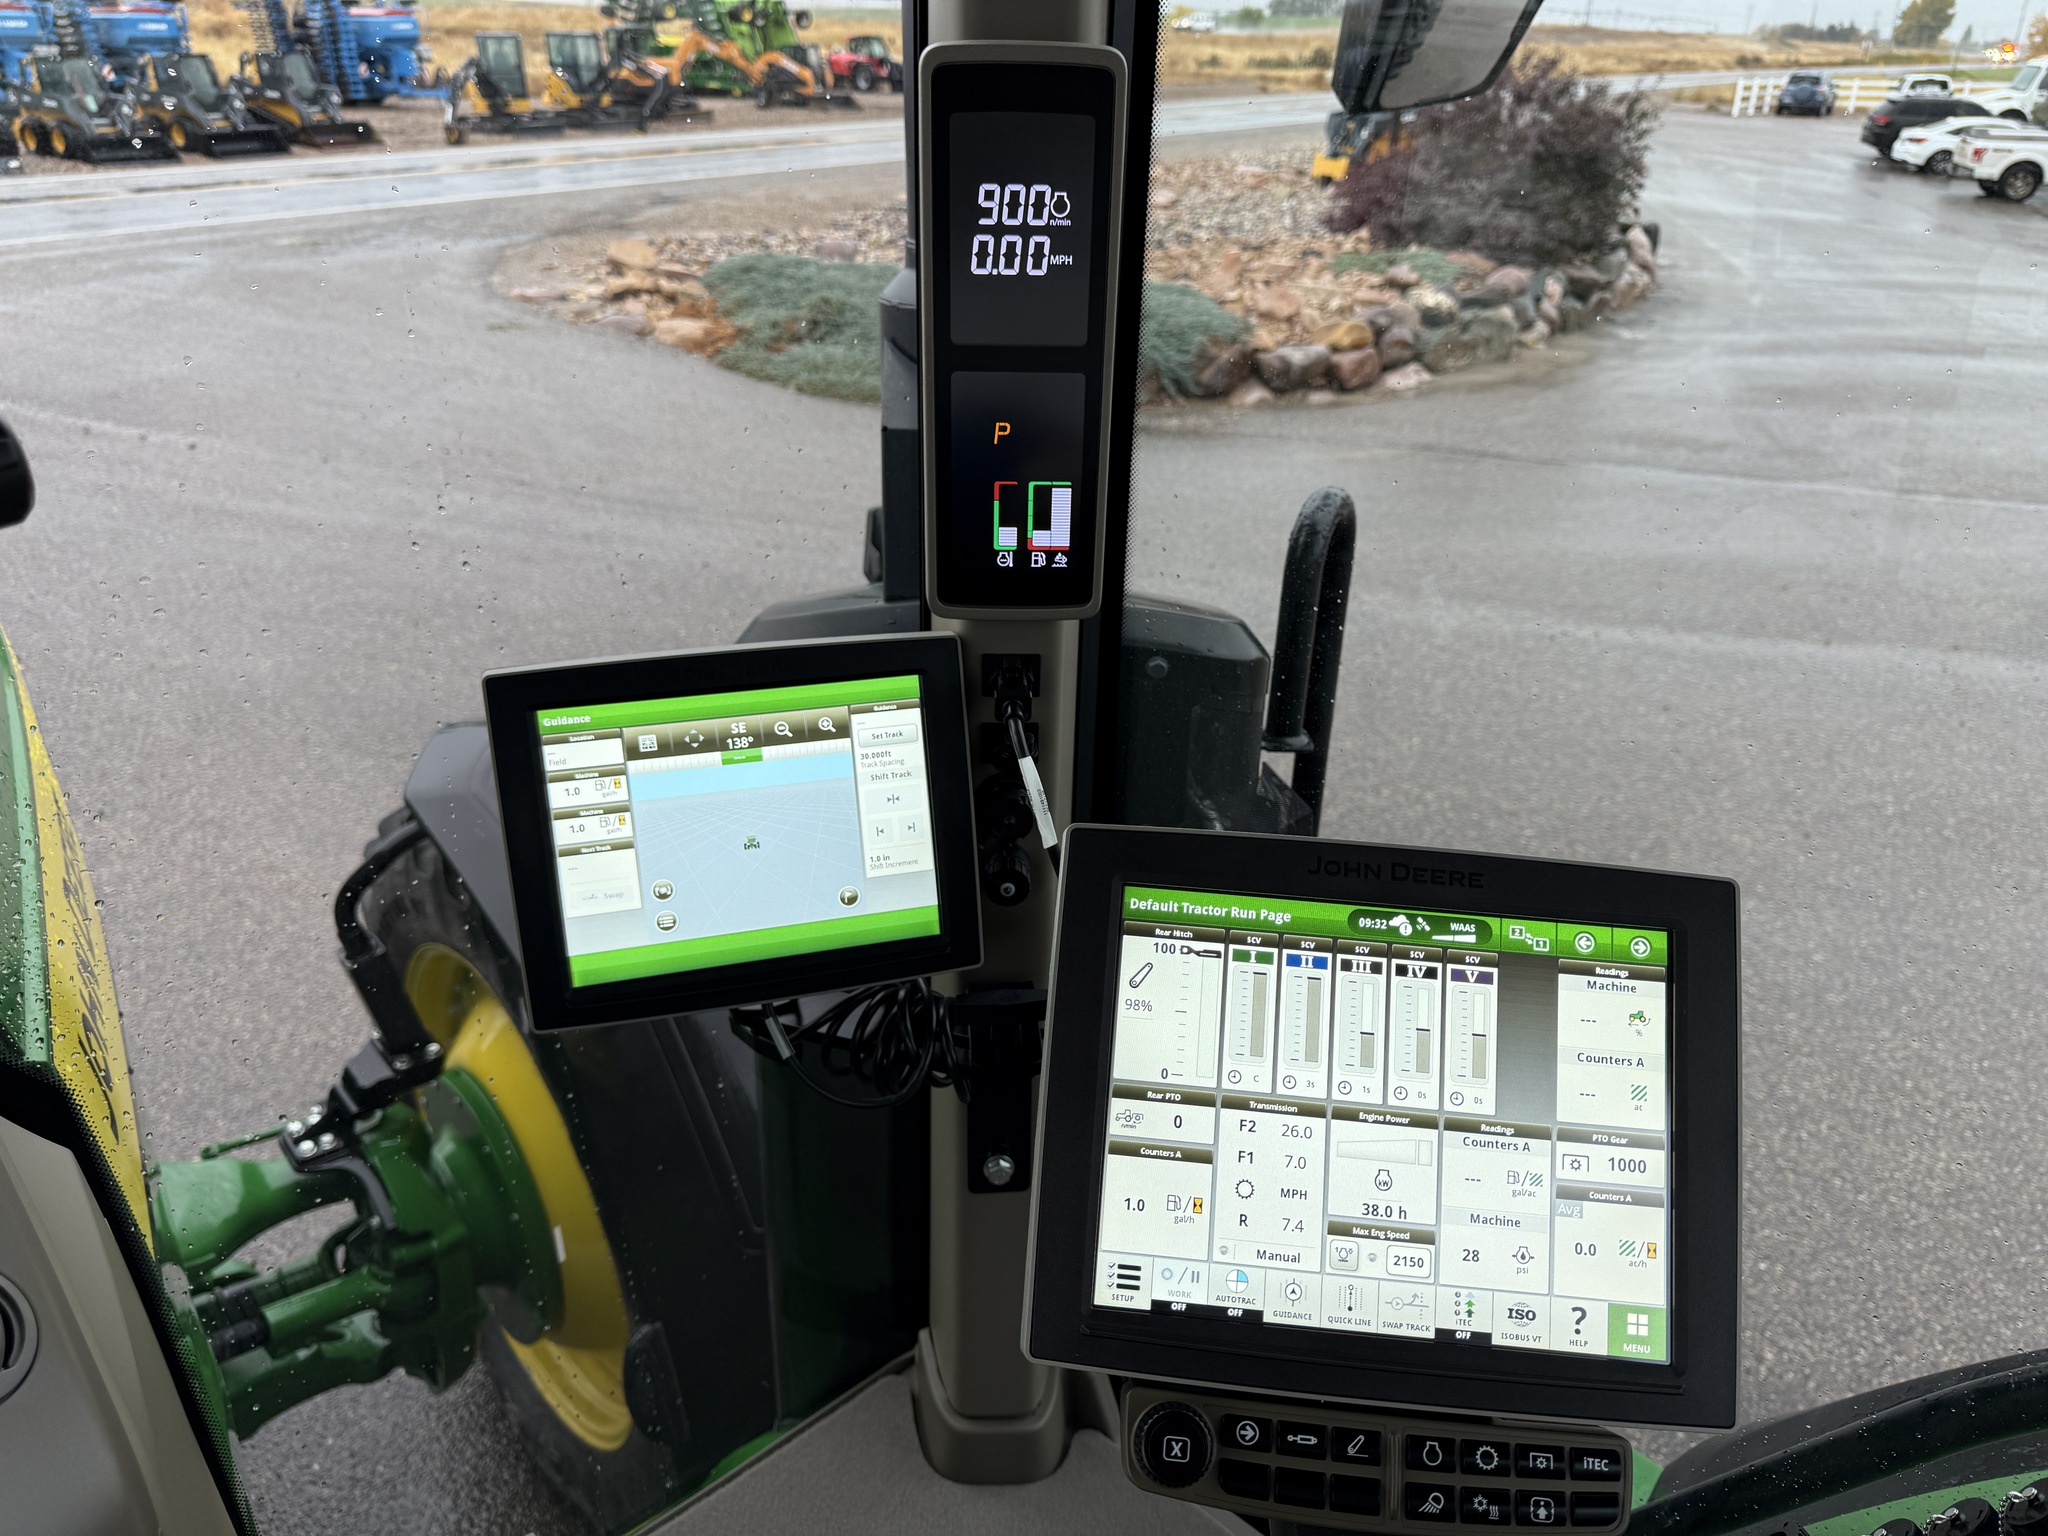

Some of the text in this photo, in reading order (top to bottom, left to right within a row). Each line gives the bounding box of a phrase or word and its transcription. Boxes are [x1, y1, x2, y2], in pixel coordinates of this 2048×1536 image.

[978, 183, 1051, 226] 900
[971, 234, 1072, 276] 0.00 MPH
[994, 422, 1010, 444] P
[543, 715, 591, 726] Guidance
[731, 722, 747, 733] SE
[872, 731, 903, 740] Set Track
[549, 758, 567, 766] Field
[861, 758, 905, 768] Track Spacing
[871, 770, 912, 781] Shift Track
[564, 787, 580, 797] 1.0
[569, 824, 585, 833] 1.0
[870, 854, 891, 863] 1.0 in
[1307, 855, 1484, 889] JOHN DEERE
[604, 891, 624, 900] Swap
[1130, 898, 1292, 925] Default Tractor Run Page
[1358, 917, 1388, 930] 09:32
[1450, 922, 1476, 933] WAAS
[1155, 928, 1193, 939] Rear Hitch
[1247, 936, 1262, 944] SCV
[1301, 941, 1316, 949] SCV
[1153, 942, 1176, 955] 100
[1355, 945, 1370, 954] SCV
[1410, 951, 1425, 960] SCV
[1465, 955, 1481, 965] SCV
[1300, 955, 1314, 969] II
[1351, 960, 1372, 974] III
[1407, 965, 1428, 979] IV
[1465, 970, 1480, 983] V
[1595, 967, 1630, 979] Readings
[1587, 980, 1638, 994] Machine
[1125, 998, 1153, 1012] 98%
[1577, 1052, 1645, 1068] Counters A
[1161, 1068, 1169, 1080] 0
[1253, 1074, 1260, 1083] C
[1306, 1080, 1315, 1089] 3s
[1363, 1085, 1371, 1094] 1s
[1147, 1090, 1182, 1101] Rear PTO
[1418, 1091, 1427, 1100] 0s
[1474, 1096, 1483, 1105] 0s
[1249, 1100, 1298, 1113] Transmission
[1634, 1104, 1643, 1112] ac
[1173, 1114, 1183, 1129] 0
[1359, 1112, 1411, 1124] Engine Power
[1239, 1119, 1313, 1140] F2 26.0
[1480, 1124, 1515, 1136] Readings
[1463, 1136, 1531, 1153] Counters A
[1592, 1134, 1629, 1145] PTO Gear
[1140, 1147, 1182, 1158] Counters A
[1237, 1150, 1307, 1170] F1 7.0
[1608, 1157, 1647, 1174] 1000
[1378, 1179, 1390, 1188] kW
[1280, 1187, 1308, 1201] MPH
[1512, 1188, 1537, 1198] gal/ac
[1589, 1191, 1633, 1203] Counters A
[1124, 1198, 1146, 1212] 1.0
[1361, 1203, 1408, 1220] 38.0 h
[1557, 1203, 1581, 1219] Avg
[1173, 1215, 1195, 1225] gal/h
[1239, 1213, 1305, 1233] R 7.4
[1470, 1213, 1521, 1228] Machine
[1352, 1226, 1410, 1240] Max Eng Speed
[1574, 1242, 1597, 1257] 0.0
[1256, 1249, 1301, 1264] Manual
[1462, 1248, 1480, 1263] 28
[1393, 1255, 1425, 1269] 2150
[1628, 1258, 1648, 1269] ac/h
[1516, 1267, 1529, 1275] psi
[1111, 1293, 1135, 1303] SETUP
[1168, 1289, 1192, 1299] WORK
[1215, 1295, 1257, 1305] AUTOTRAC
[1171, 1302, 1187, 1312] OFF
[1227, 1308, 1244, 1317] OFF
[1273, 1310, 1313, 1321] GUIDANCE
[1507, 1307, 1537, 1322] ISO
[1327, 1315, 1372, 1327] QUICK LINE
[1382, 1321, 1431, 1332] SWAP TRACK
[1455, 1318, 1472, 1327] iTEC
[1455, 1330, 1472, 1340] OFF
[1501, 1332, 1542, 1343] ISOBUS VT
[1569, 1338, 1589, 1348] HELP
[1623, 1343, 1651, 1354] MENU
[1583, 1456, 1609, 1471] iTEC
